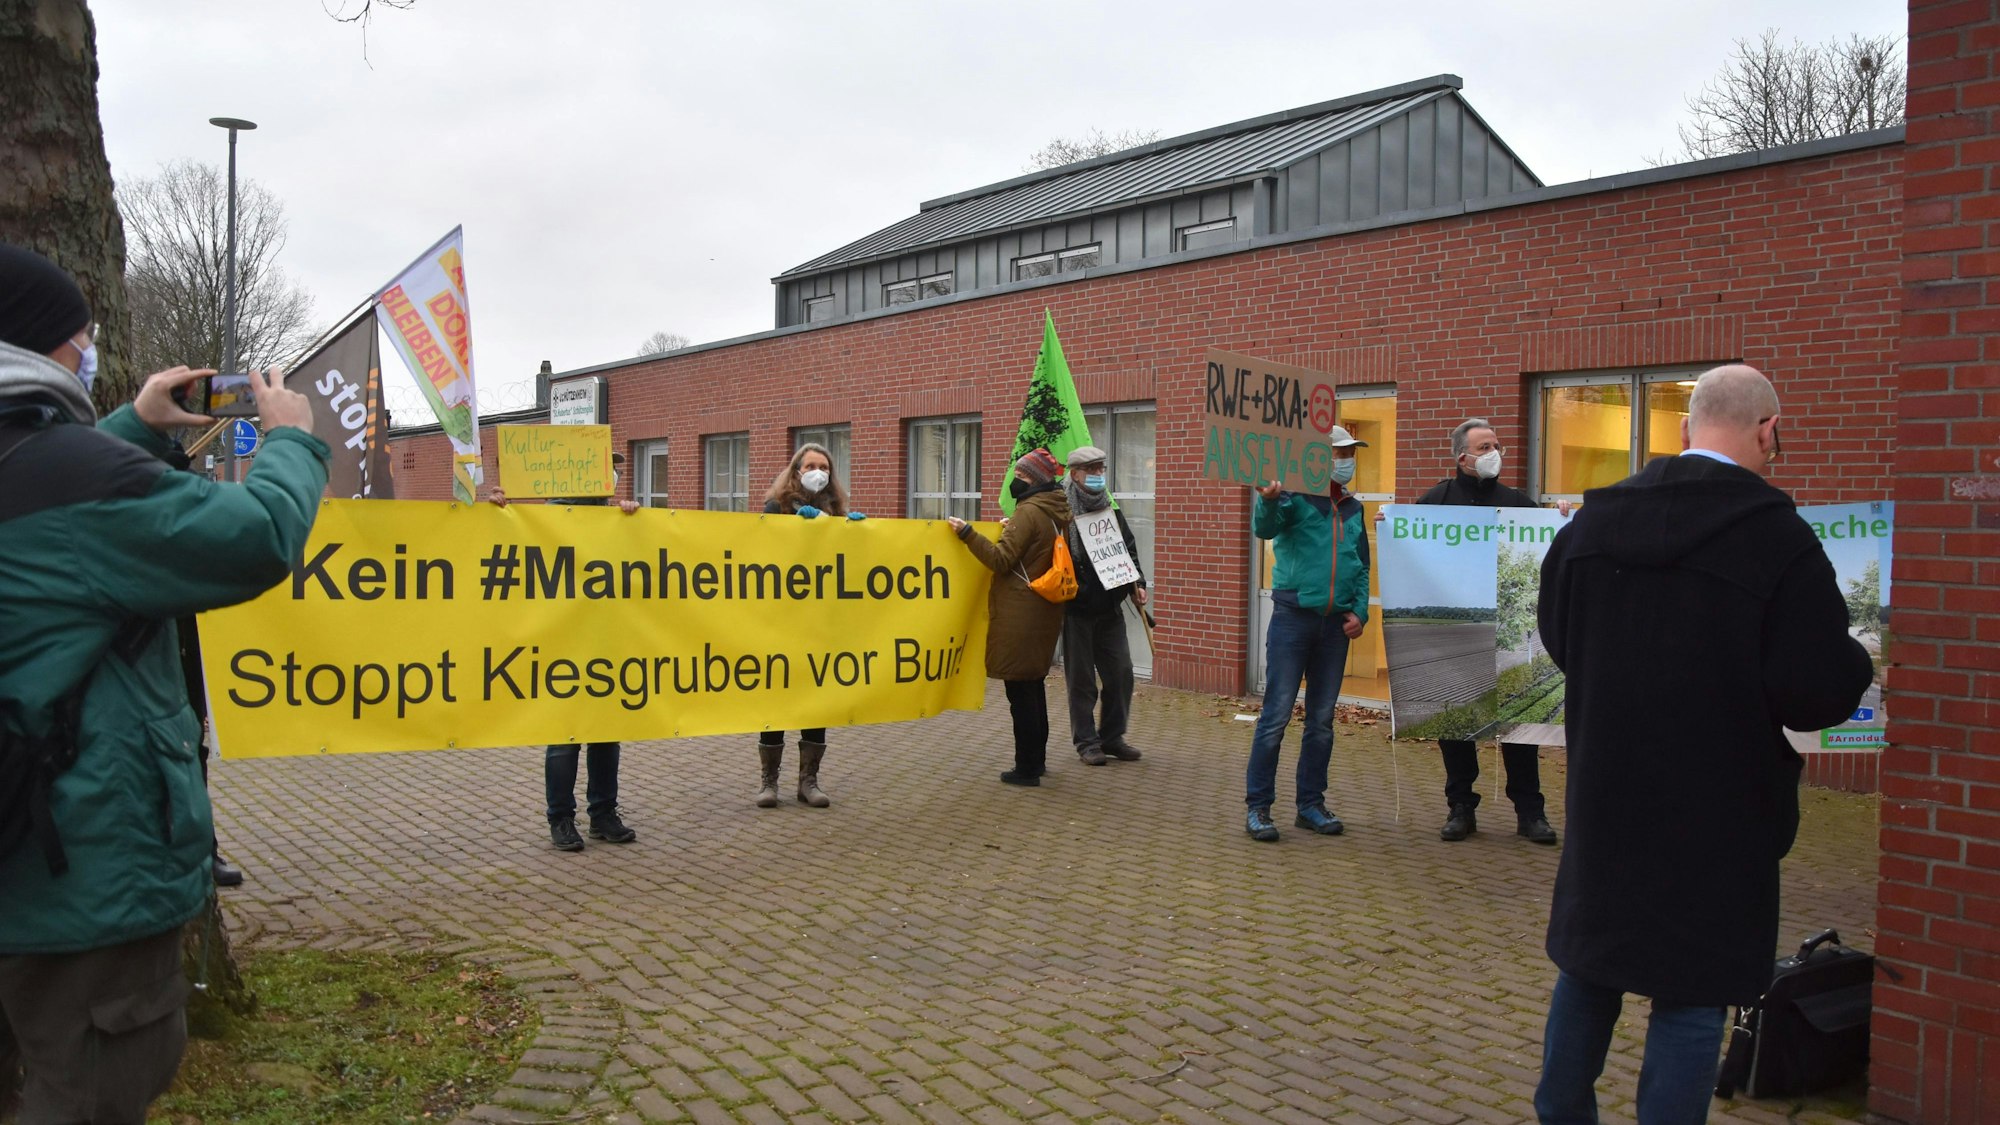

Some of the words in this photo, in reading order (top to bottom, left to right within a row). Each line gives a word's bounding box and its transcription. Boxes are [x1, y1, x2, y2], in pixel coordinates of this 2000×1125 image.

[380, 285, 450, 382] BLEIBEN
[504, 429, 565, 454] Kultur-
[524, 447, 598, 475] landschaft
[1088, 518, 1116, 537] OPA
[1393, 517, 1555, 546] Bürgerinn
[1810, 514, 1888, 540] ache
[1090, 541, 1128, 563] ZUKUNFT
[292, 543, 454, 600] Kein
[480, 544, 950, 600] #ManheimerLoch
[228, 648, 457, 719] Stoppt
[483, 643, 789, 711] Kiesgruben
[807, 650, 878, 687] vor
[894, 633, 967, 684] Buir!
[1858, 710, 1864, 719] 4
